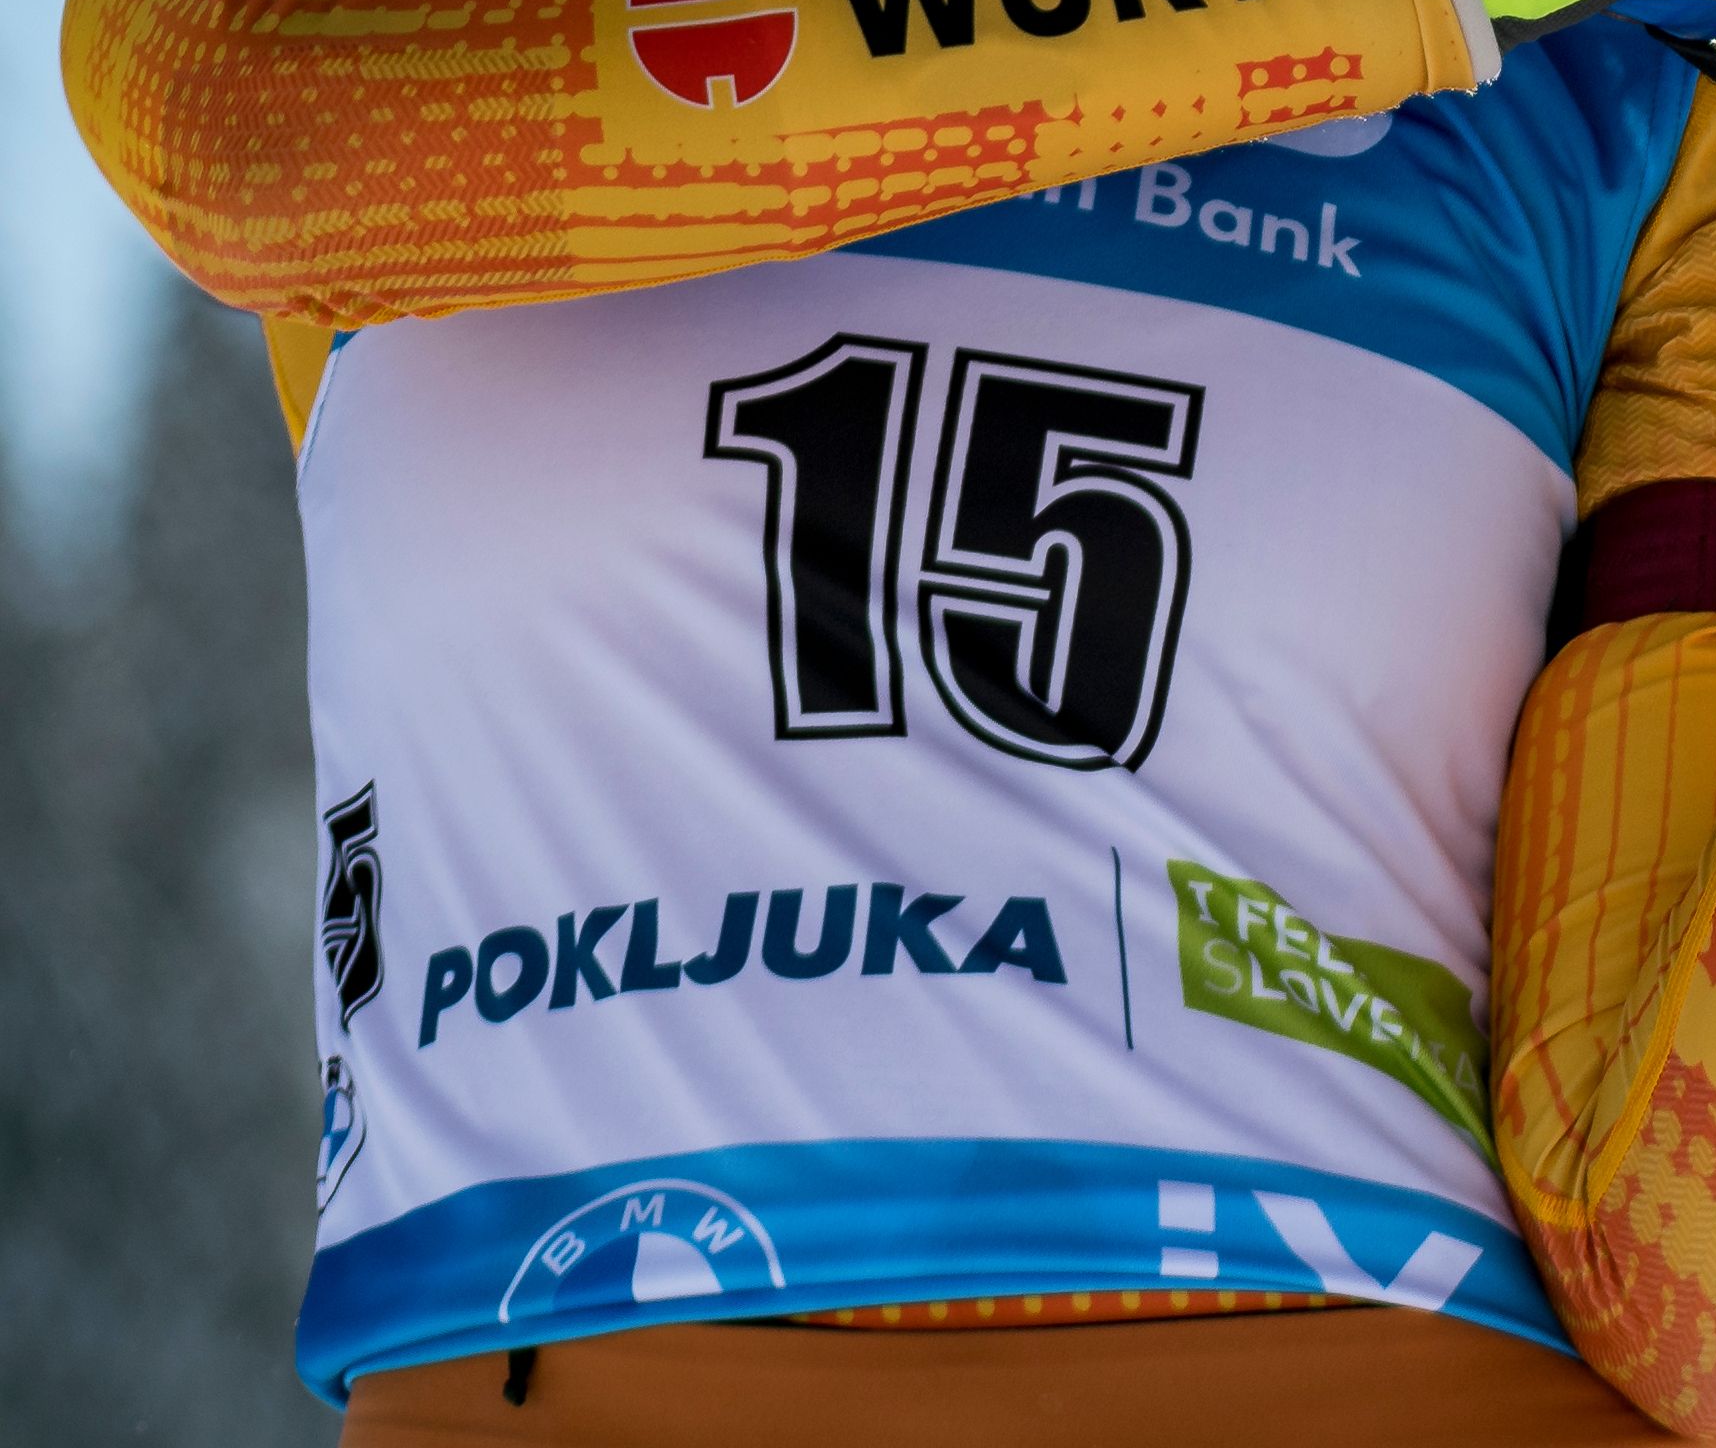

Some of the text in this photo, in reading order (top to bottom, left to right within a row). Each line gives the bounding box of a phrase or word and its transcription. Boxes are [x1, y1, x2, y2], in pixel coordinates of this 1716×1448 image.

[1135, 161, 1362, 278] Bank
[702, 331, 1207, 773] 15
[418, 881, 1068, 1050] POKLJUKA
[541, 1192, 745, 1277] BMW
